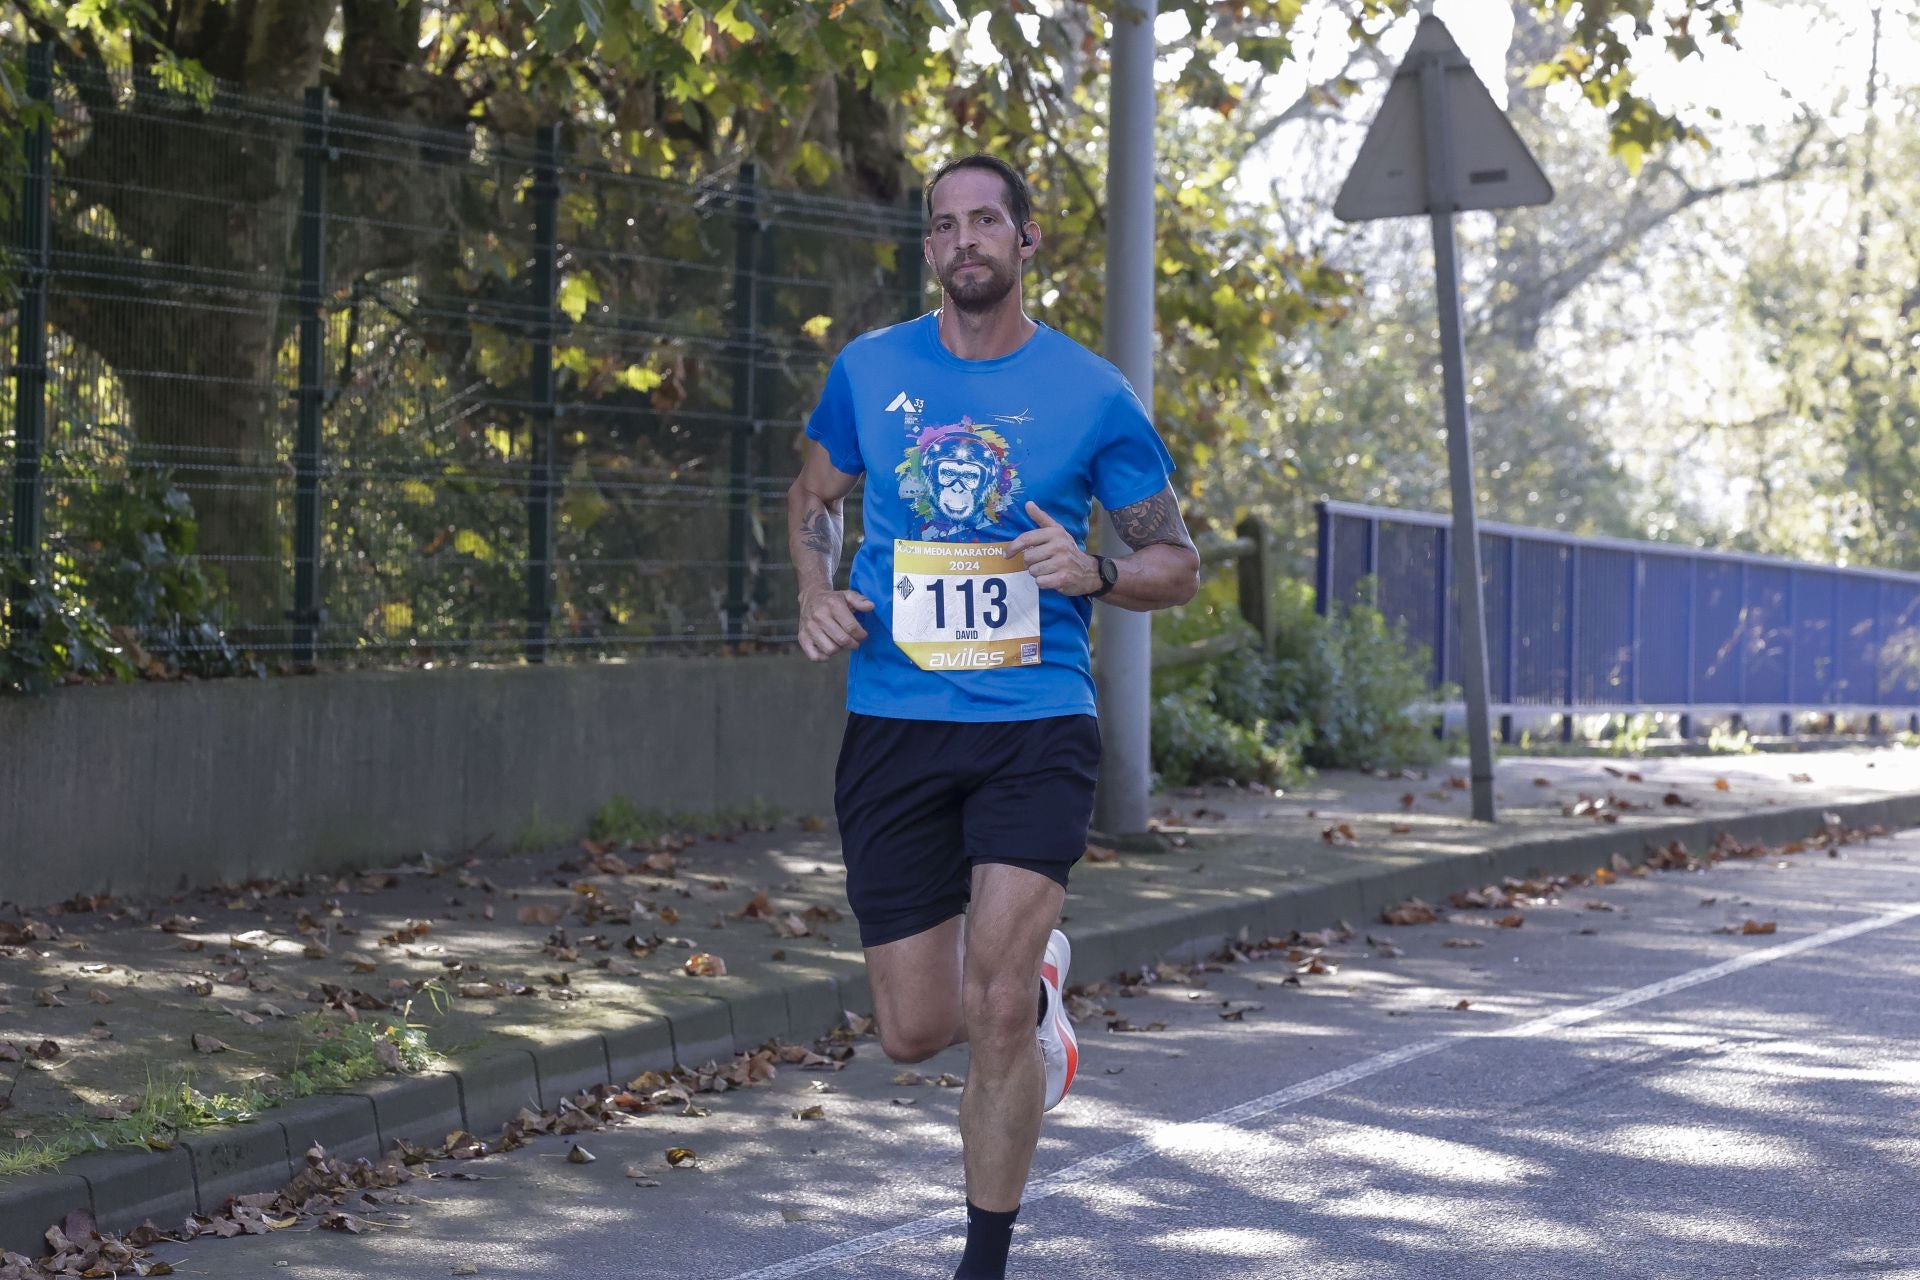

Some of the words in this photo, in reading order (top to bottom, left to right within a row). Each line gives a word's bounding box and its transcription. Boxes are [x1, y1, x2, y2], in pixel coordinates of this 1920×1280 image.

[914, 398, 925, 408] 33
[923, 547, 952, 556] MEDIA
[954, 545, 1003, 556] MARATÓN
[949, 561, 980, 571] 2024
[926, 577, 1008, 629] 113
[955, 630, 978, 640] DAVID
[929, 648, 1005, 667] avilés
